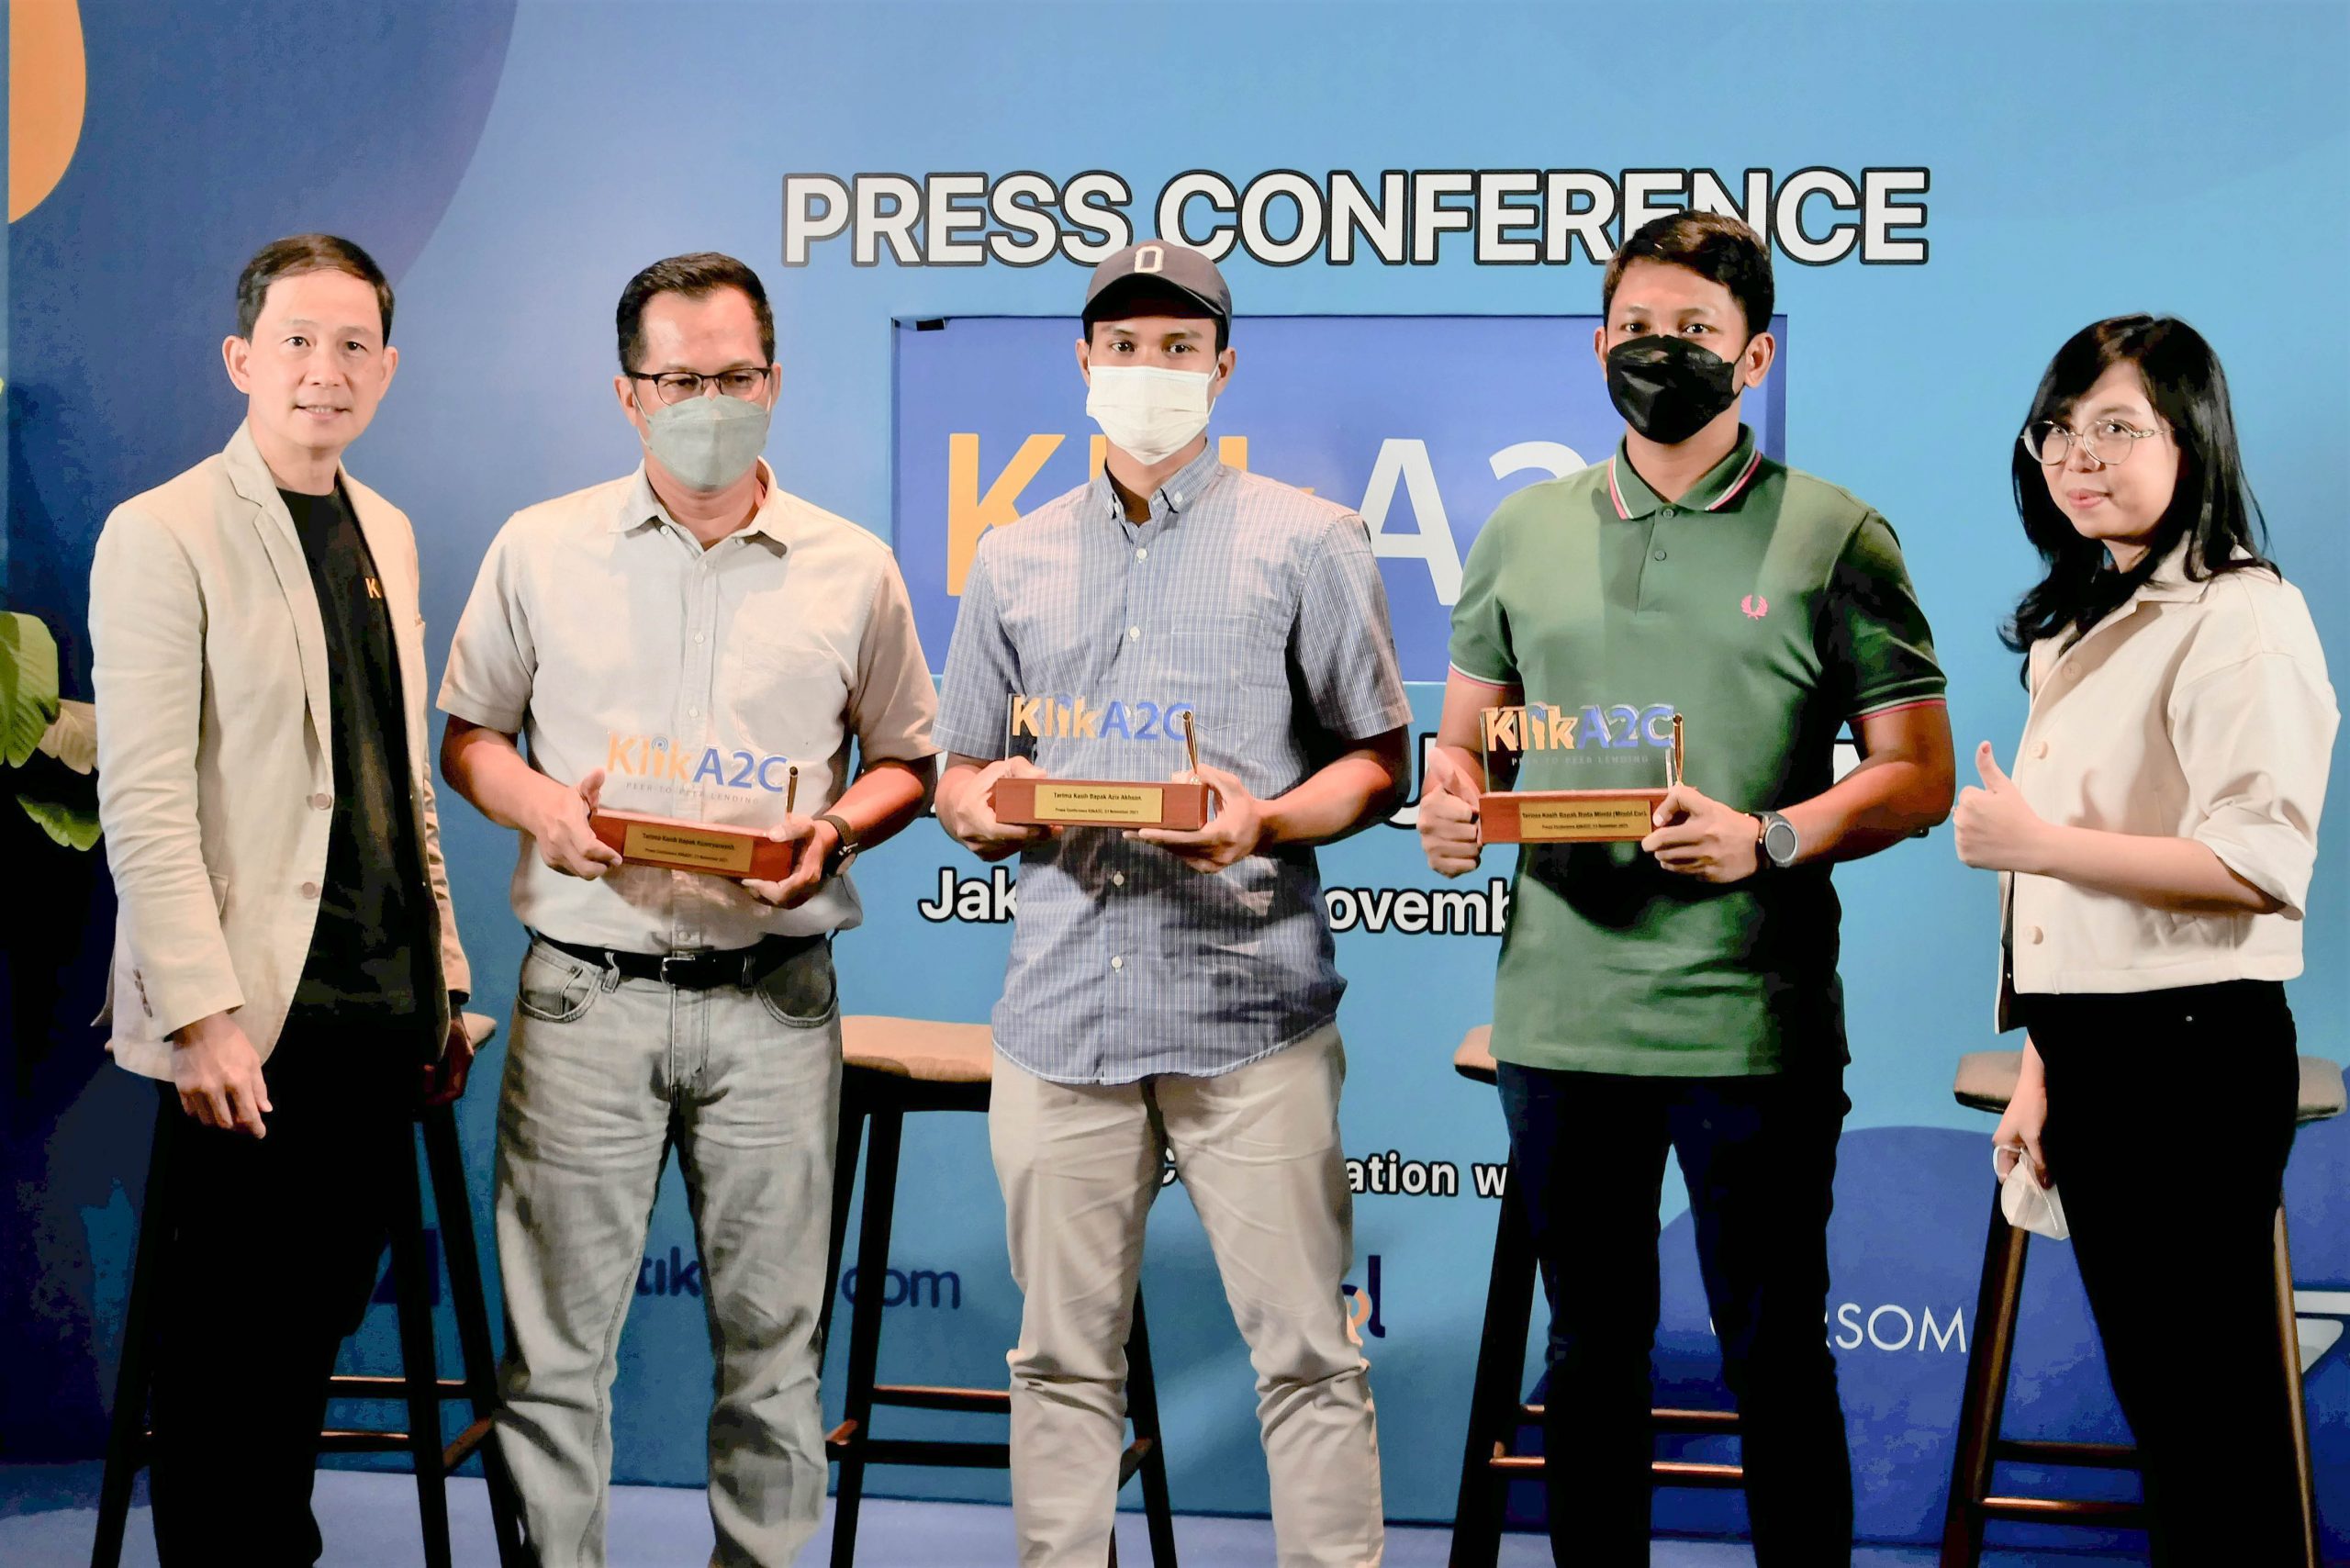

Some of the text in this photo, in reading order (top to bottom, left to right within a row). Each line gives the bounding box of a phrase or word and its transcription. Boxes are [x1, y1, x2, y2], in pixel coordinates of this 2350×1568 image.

[782, 167, 1930, 266] PRESS CONFERENCE
[917, 866, 1017, 923] Jak
[1325, 878, 1509, 935] ovemb
